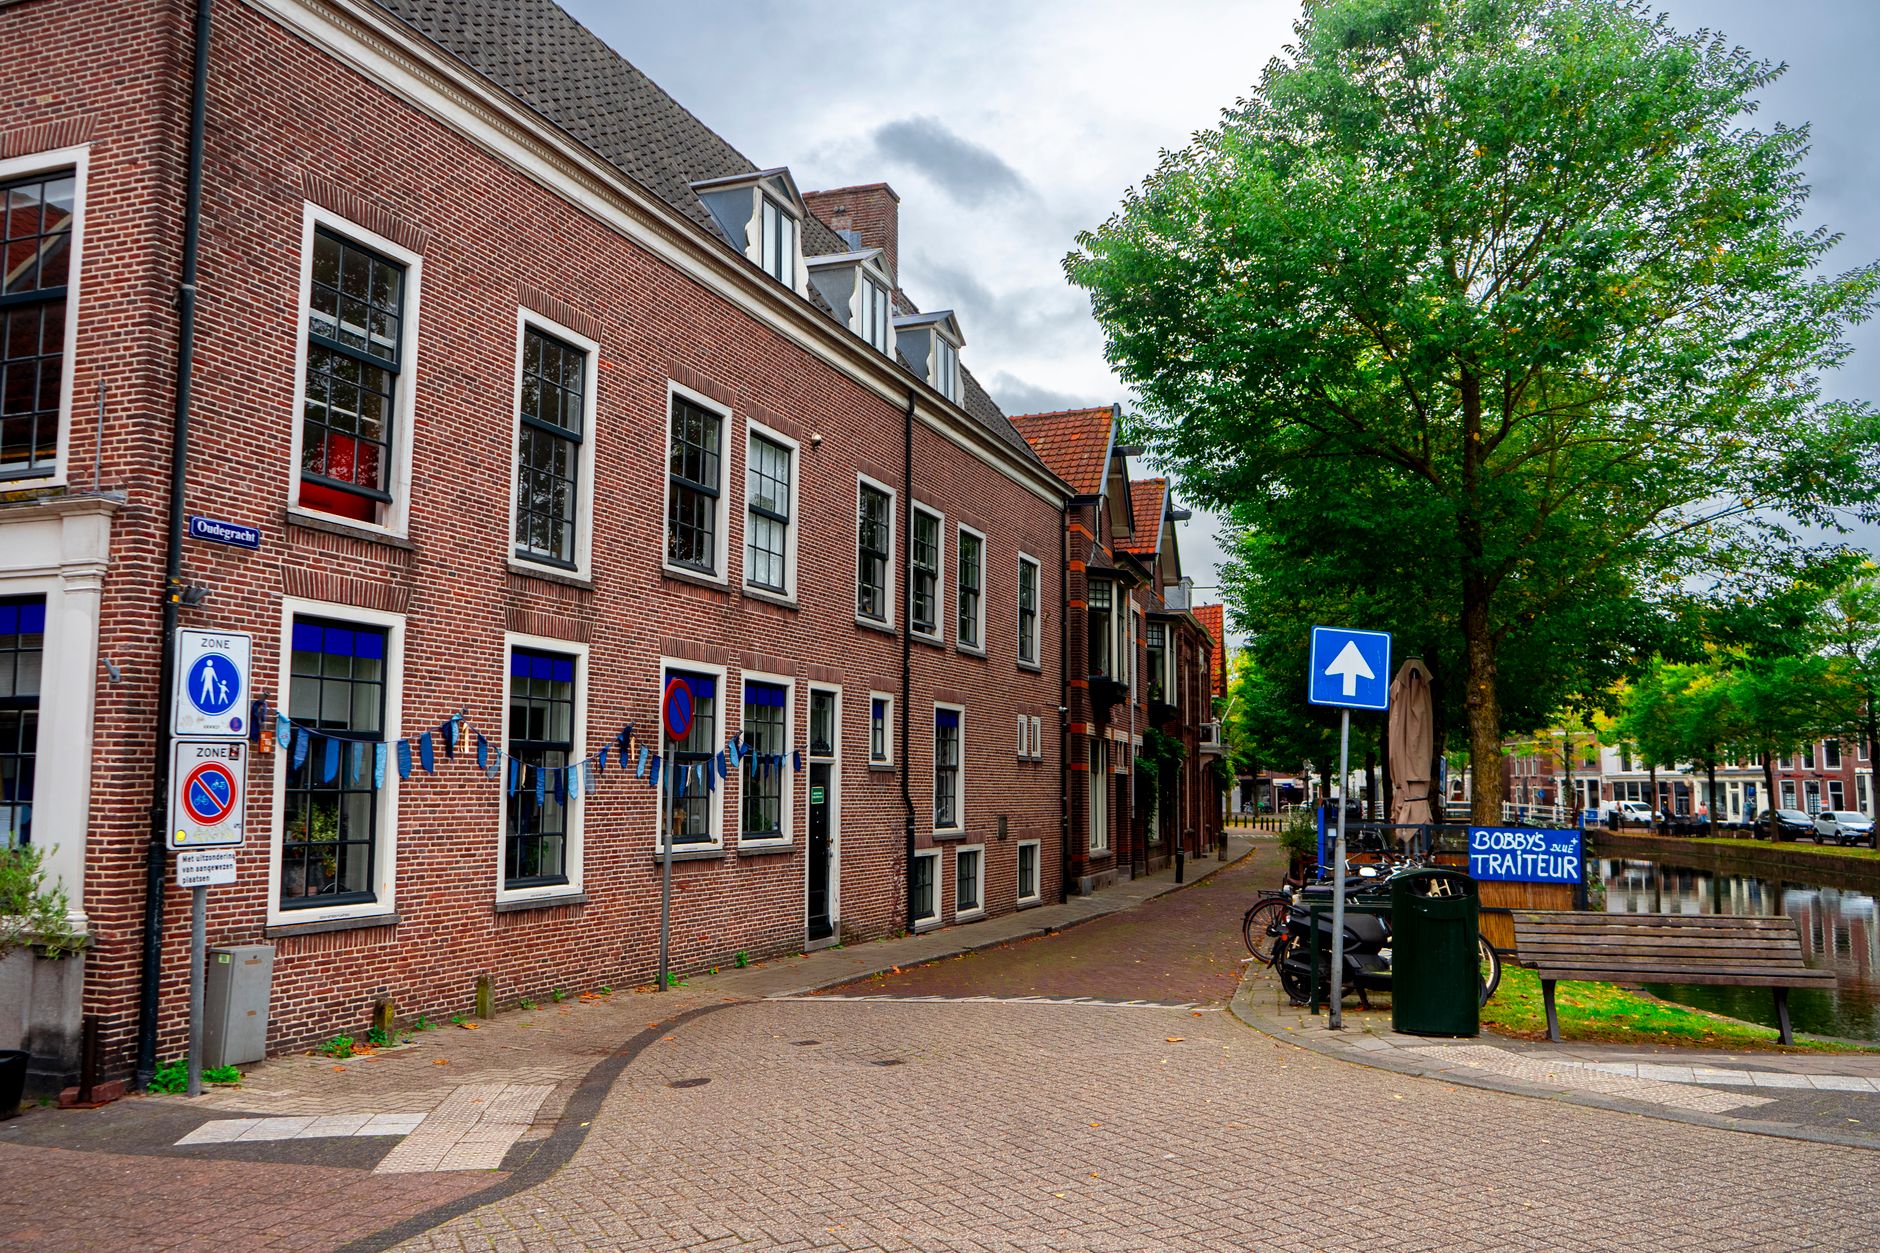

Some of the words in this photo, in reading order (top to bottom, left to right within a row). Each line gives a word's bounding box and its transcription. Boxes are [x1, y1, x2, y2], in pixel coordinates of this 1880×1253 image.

[197, 521, 255, 542] Oudegracht
[201, 639, 230, 649] ZONE
[196, 747, 227, 757] ZONE
[1472, 831, 1546, 851] BOBBY'S
[1550, 843, 1574, 853] BLUE
[196, 863, 233, 873] aangewezen
[183, 875, 210, 884] plaatsen
